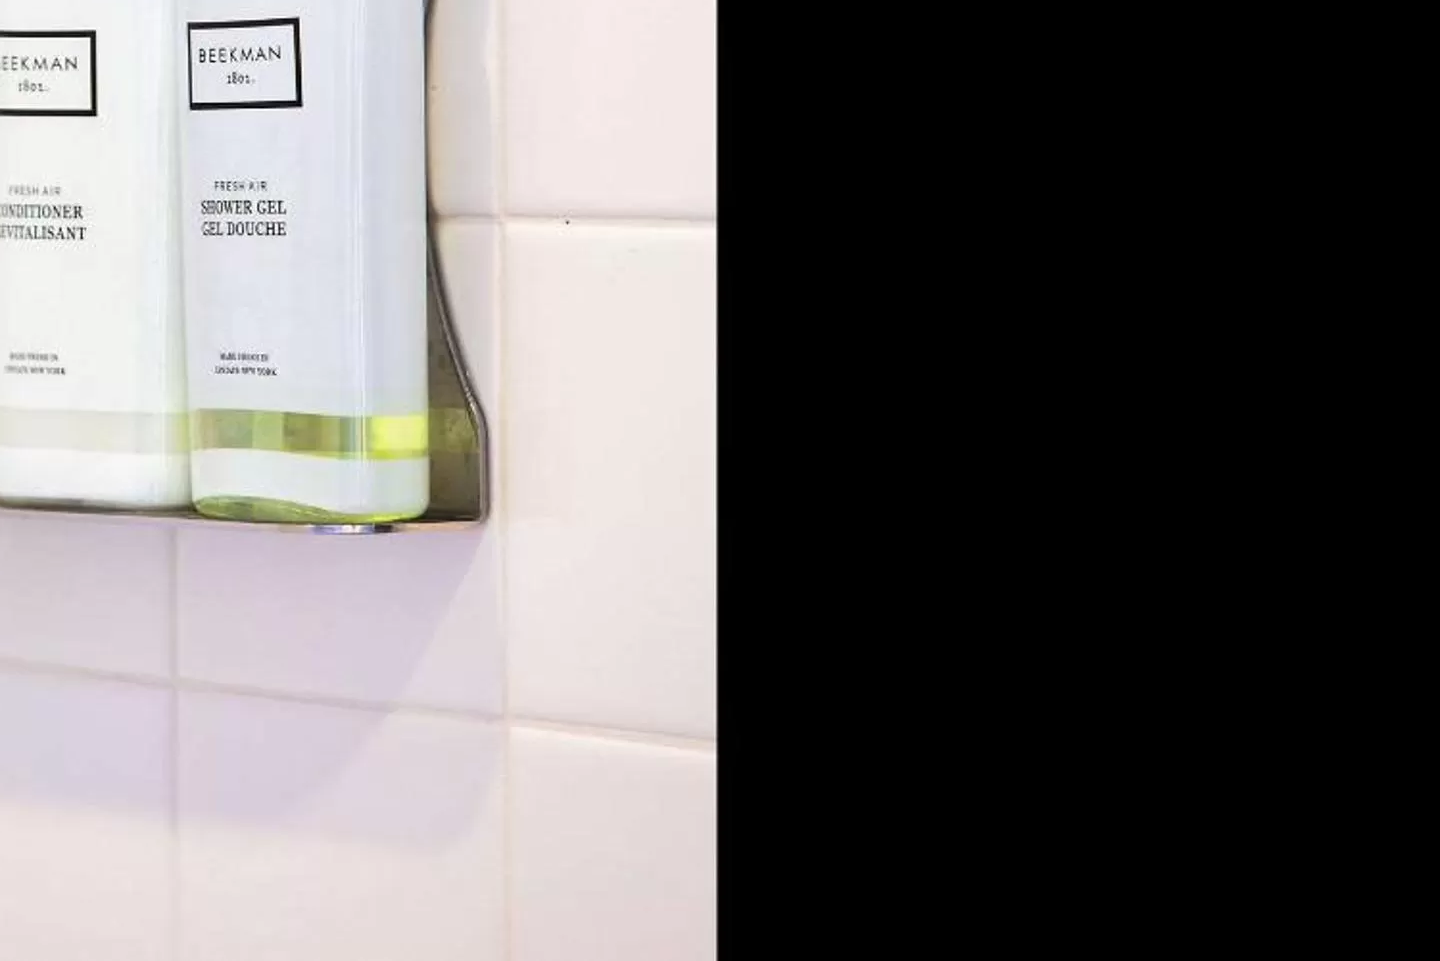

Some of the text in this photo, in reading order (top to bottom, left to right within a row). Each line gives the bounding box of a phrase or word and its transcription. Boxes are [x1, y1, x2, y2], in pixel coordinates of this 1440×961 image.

[198, 45, 282, 63] BEEKMAN
[213, 180, 268, 192] FRESH AIR
[200, 199, 287, 215] SHOWER GEL
[201, 221, 287, 236] GEL DOUCHE
